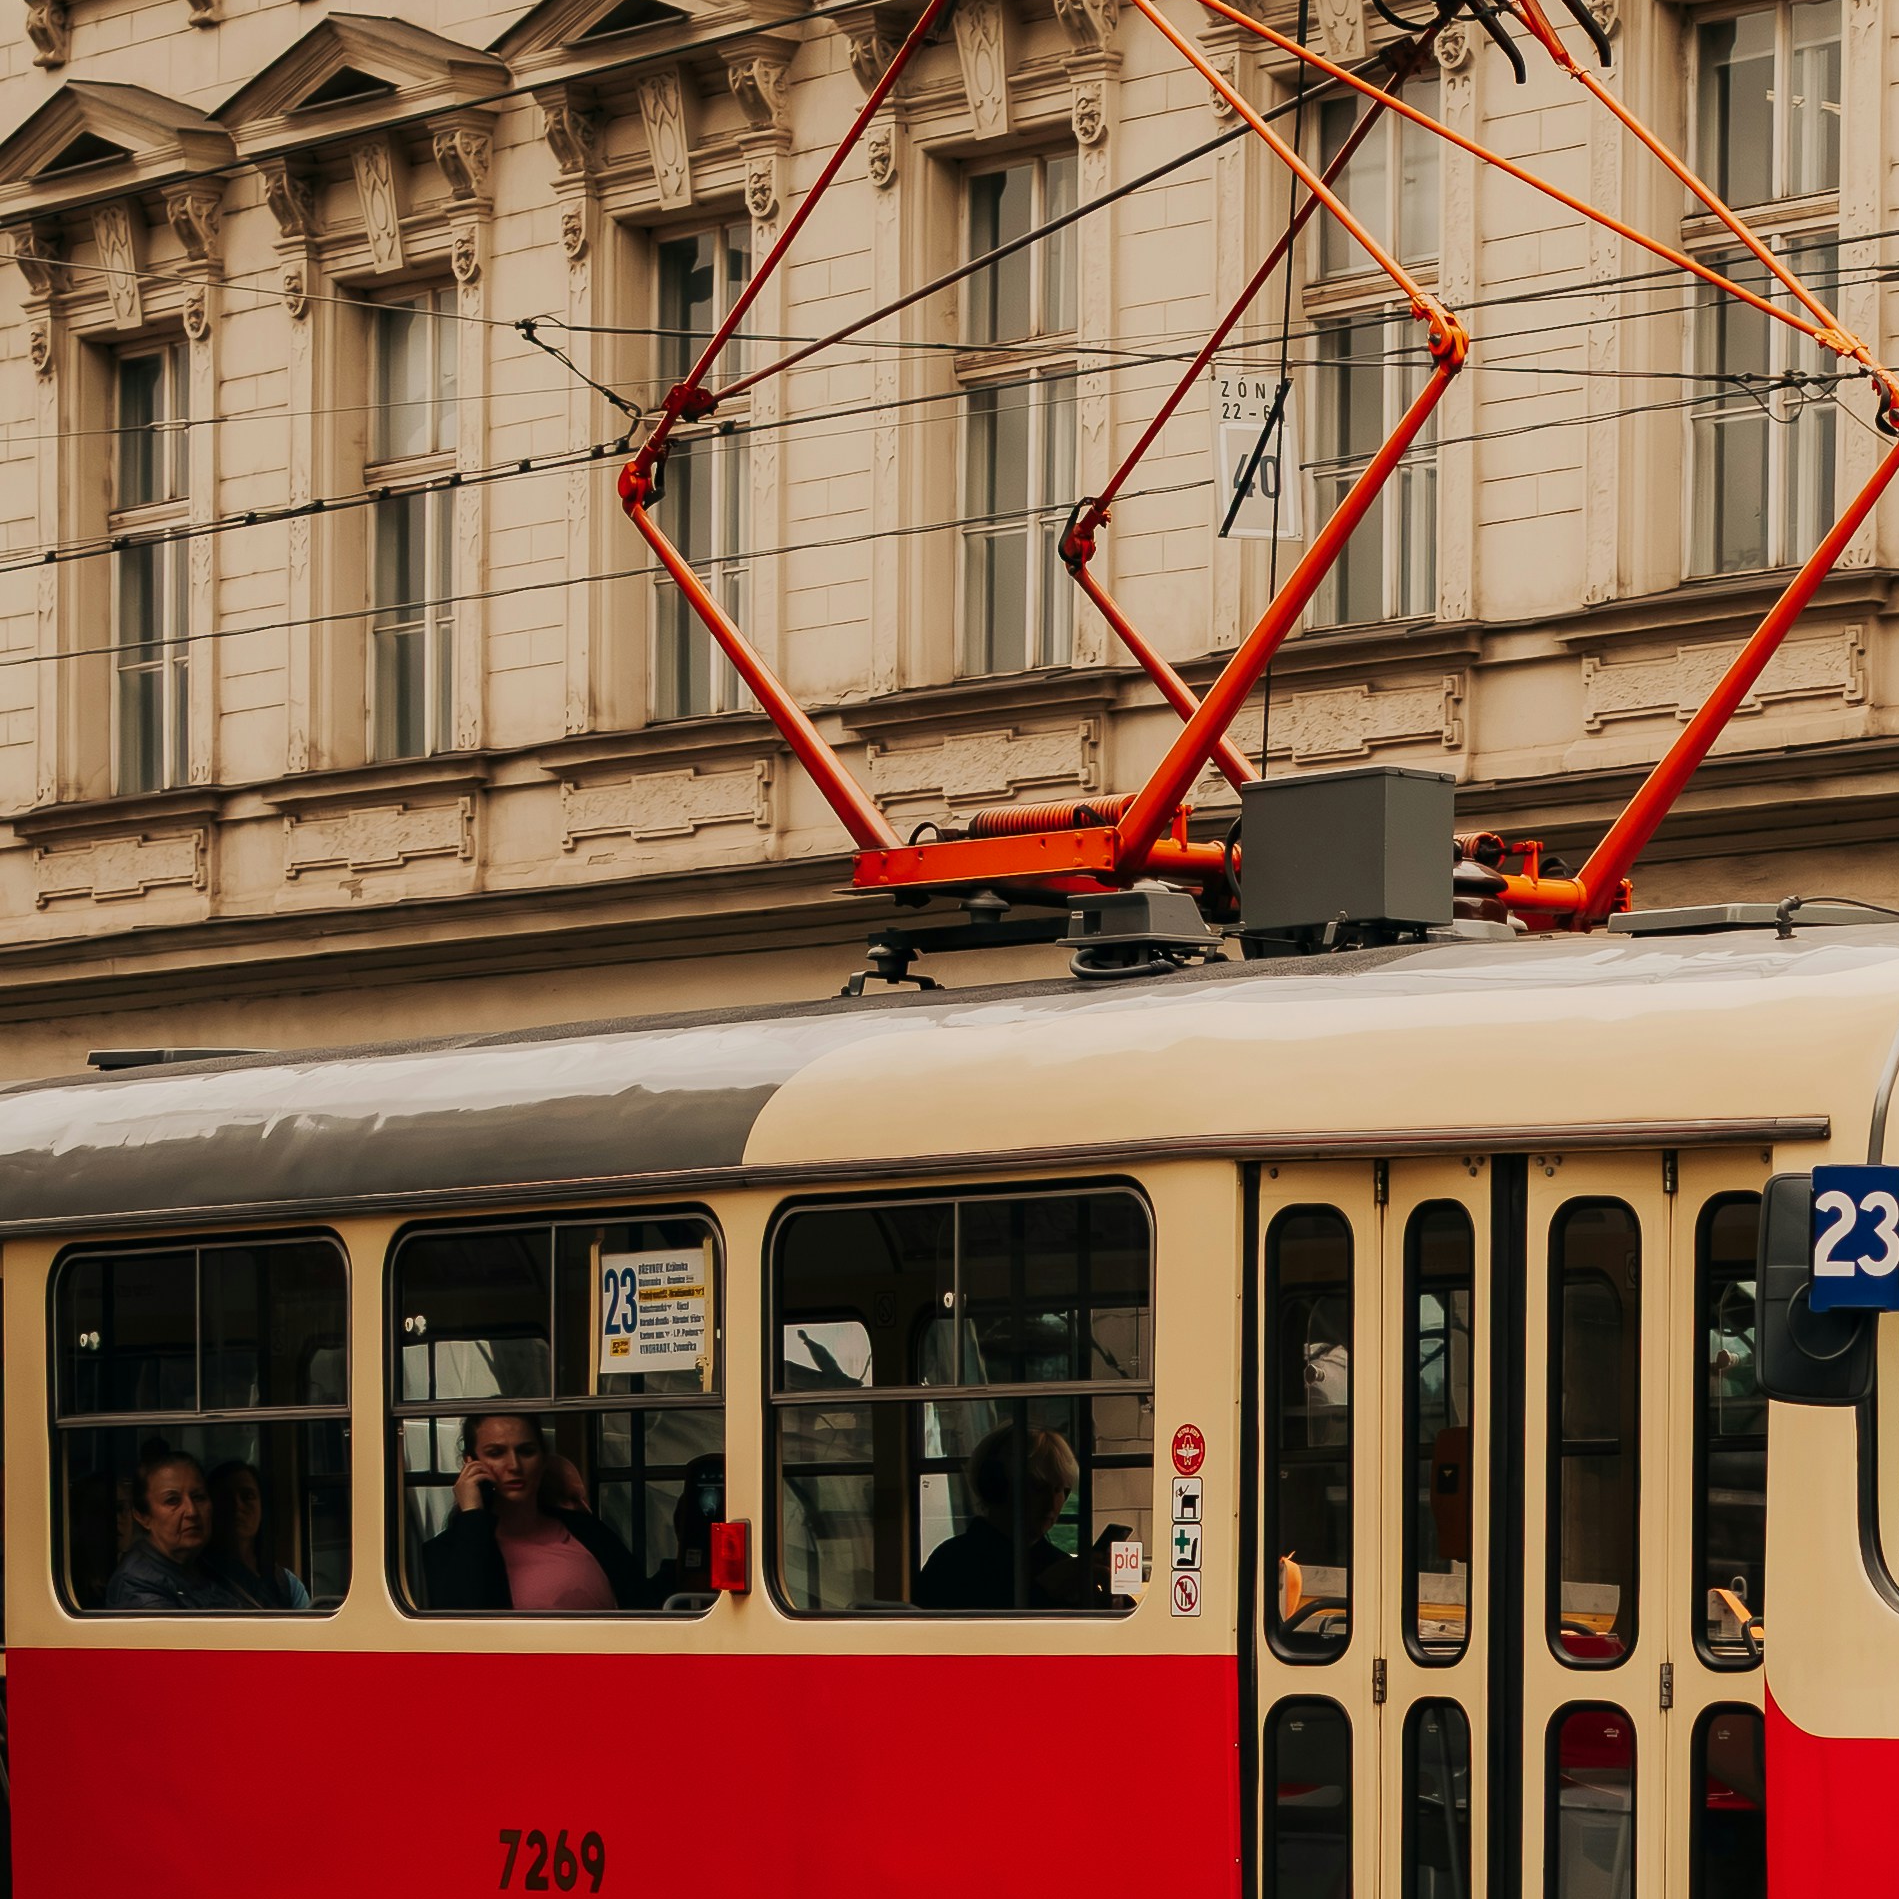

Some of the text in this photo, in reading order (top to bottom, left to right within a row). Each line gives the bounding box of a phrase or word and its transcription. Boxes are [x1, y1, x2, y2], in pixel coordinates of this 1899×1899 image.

[1222, 402, 1242, 420] 22
[1233, 453, 1282, 499] 40
[604, 1267, 638, 1336] 23
[1114, 1546, 1139, 1575] pid
[498, 1828, 606, 1894] 7269
